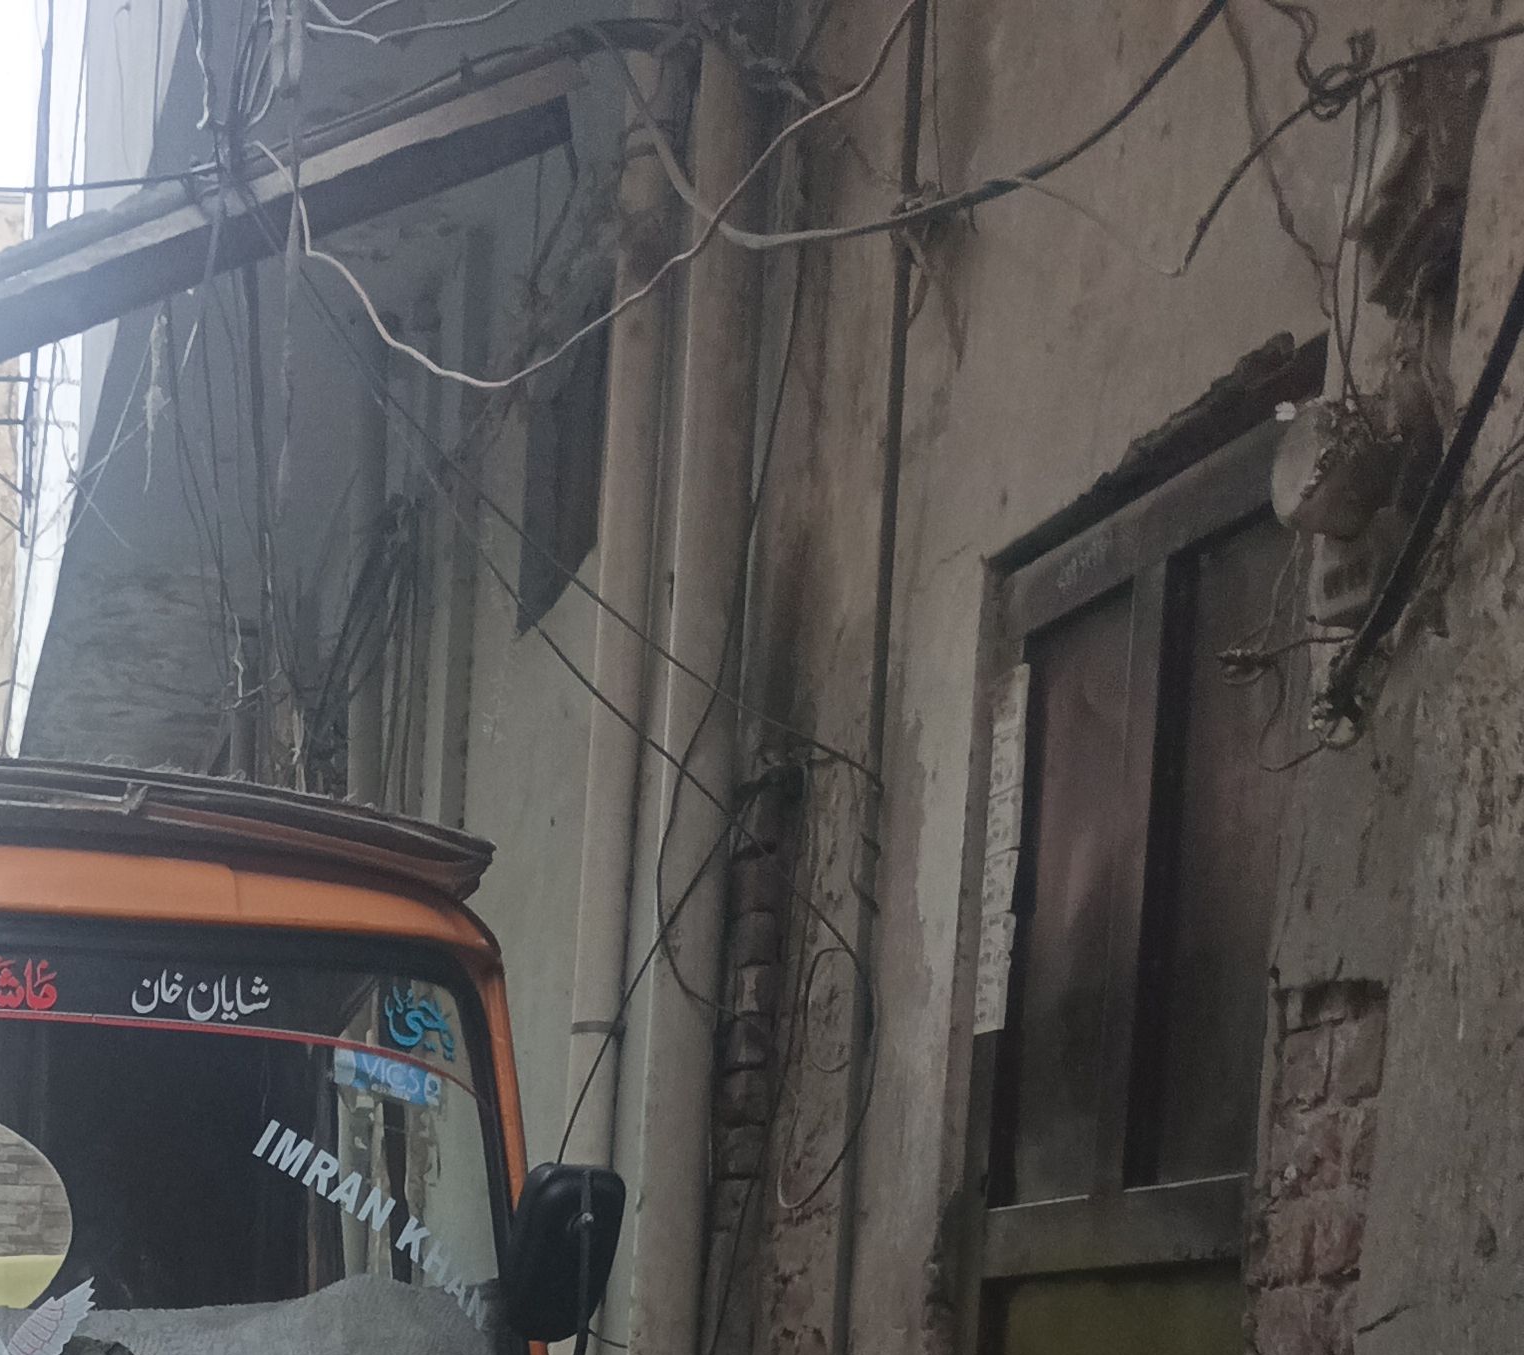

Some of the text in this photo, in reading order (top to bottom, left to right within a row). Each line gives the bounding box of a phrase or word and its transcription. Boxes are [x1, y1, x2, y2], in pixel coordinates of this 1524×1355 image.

[131, 968, 272, 1022] شایان خان
[252, 1119, 397, 1232] IMRAN
